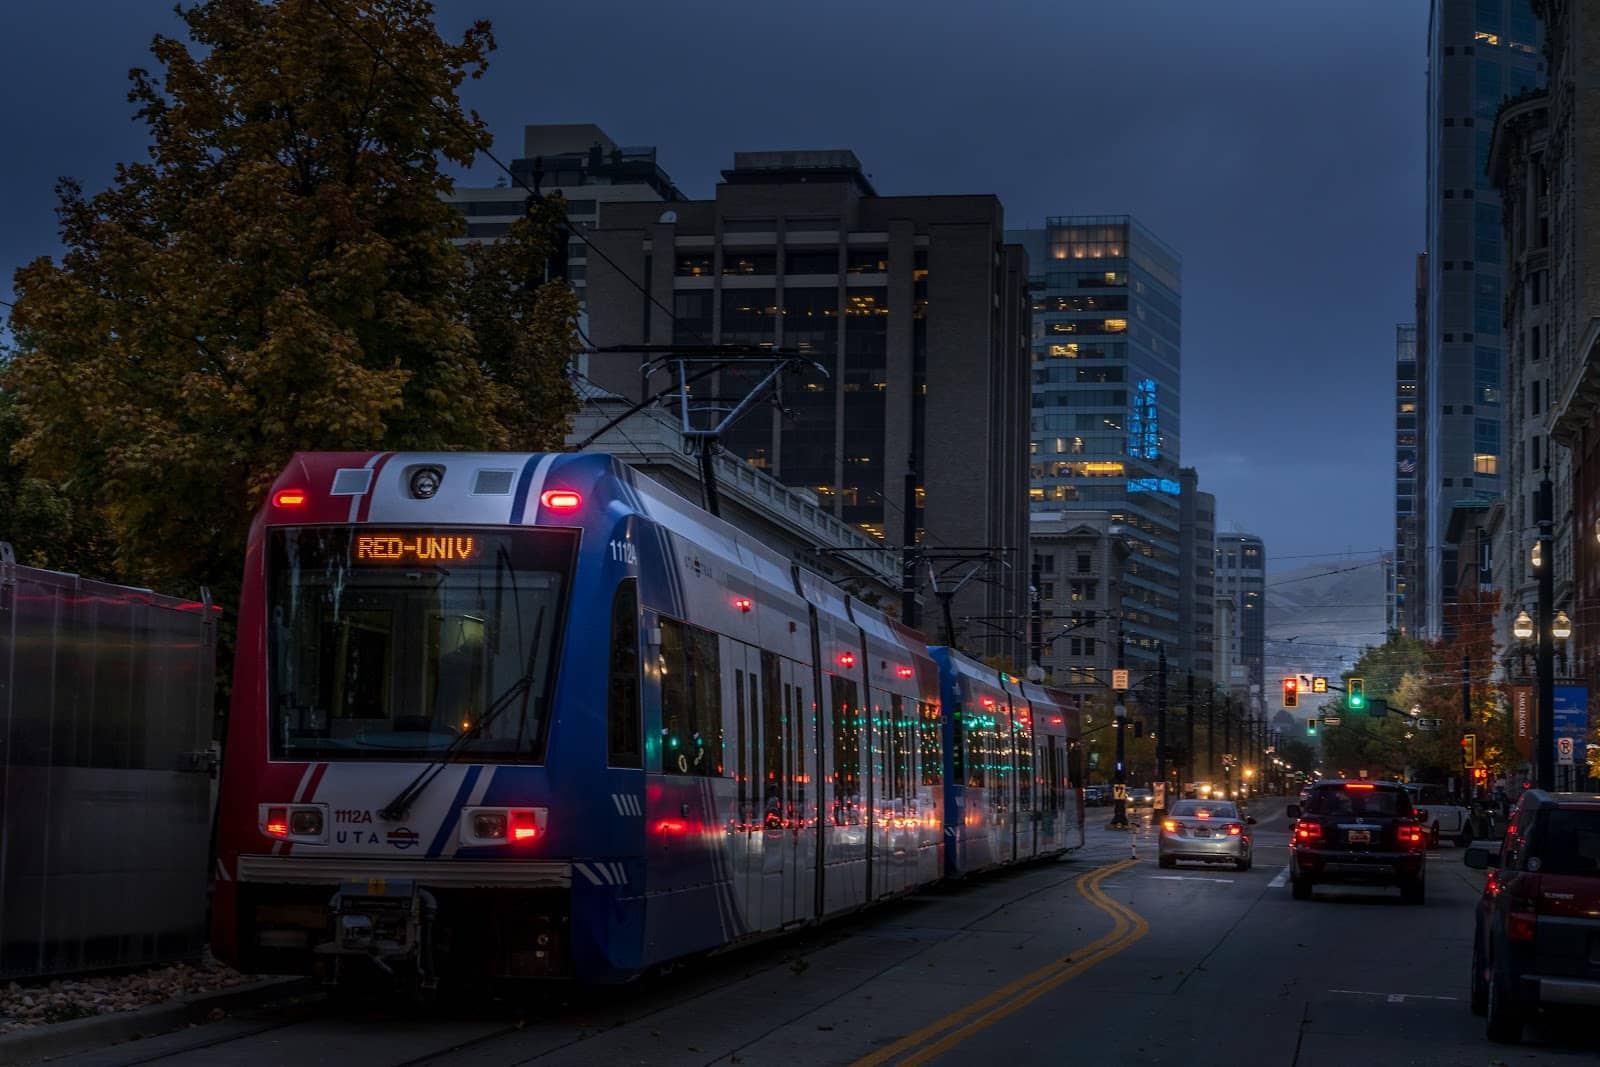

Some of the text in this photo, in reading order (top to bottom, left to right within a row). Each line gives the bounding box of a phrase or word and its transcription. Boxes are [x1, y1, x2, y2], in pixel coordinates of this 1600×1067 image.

[358, 537, 474, 559] RED-UNIV
[609, 538, 638, 566] 1112A
[1518, 691, 1527, 737] DOWNTOWN
[335, 809, 373, 824] 1112A
